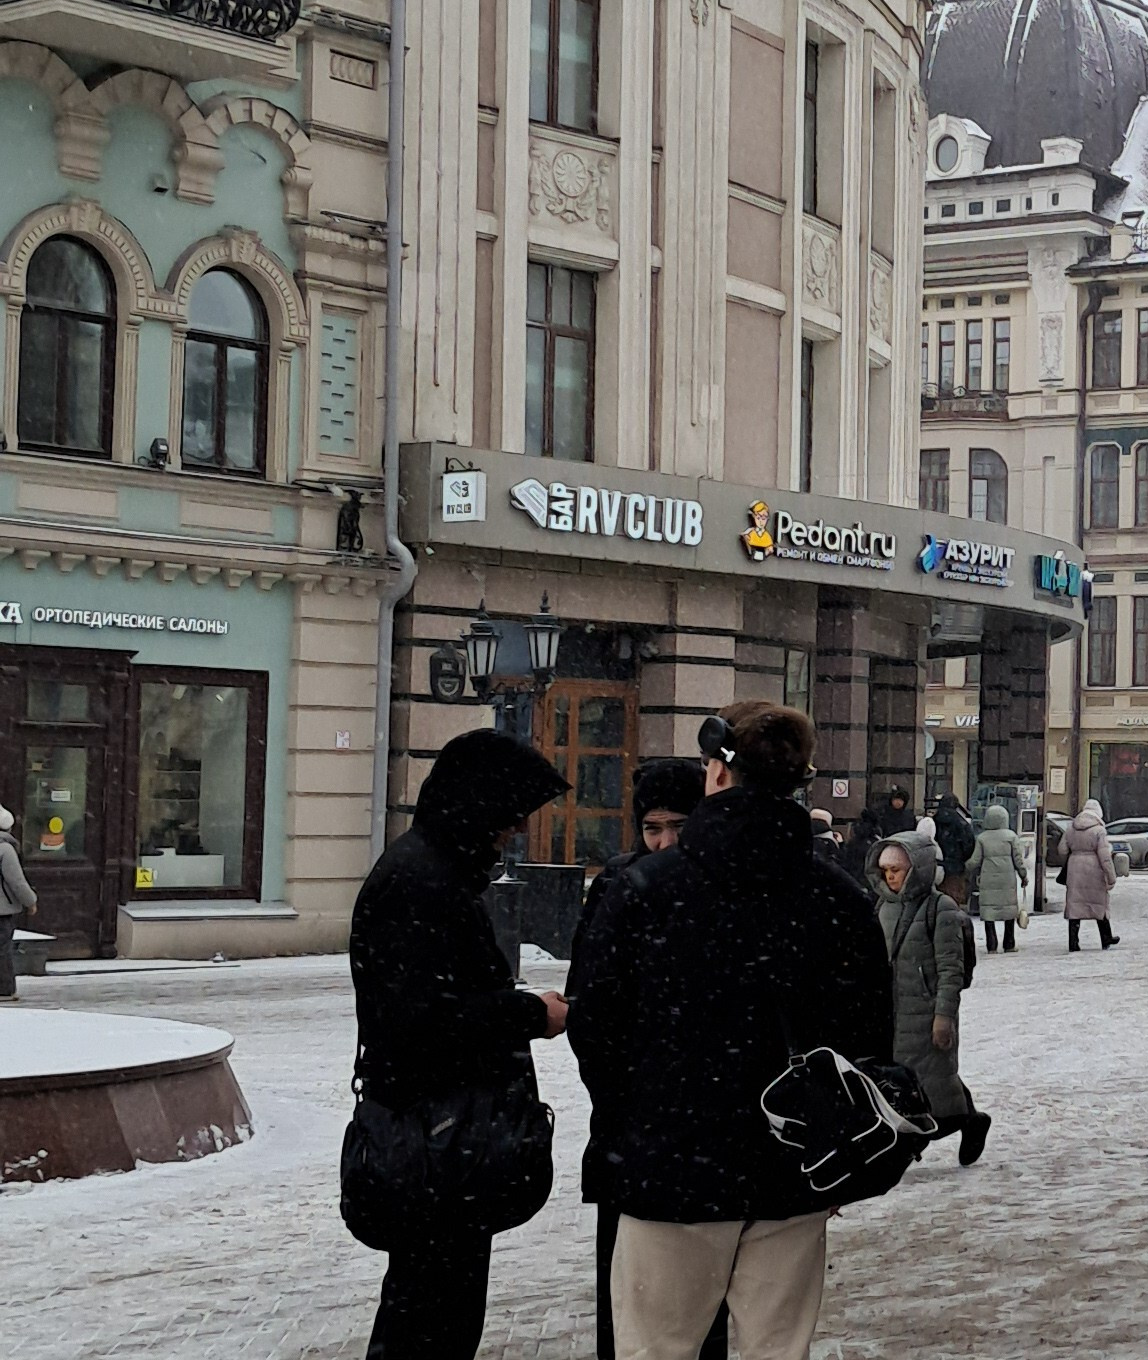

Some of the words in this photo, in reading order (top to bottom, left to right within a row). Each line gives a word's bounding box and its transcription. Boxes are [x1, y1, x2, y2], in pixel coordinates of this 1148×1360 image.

[549, 482, 574, 532] БАР
[776, 510, 896, 558] Pedant.ru
[945, 539, 1016, 569] АЗУРИТ
[32, 607, 165, 631] ОРТОПЕДИЧЕСКИЕ
[168, 616, 229, 635] САЛОНЫ
